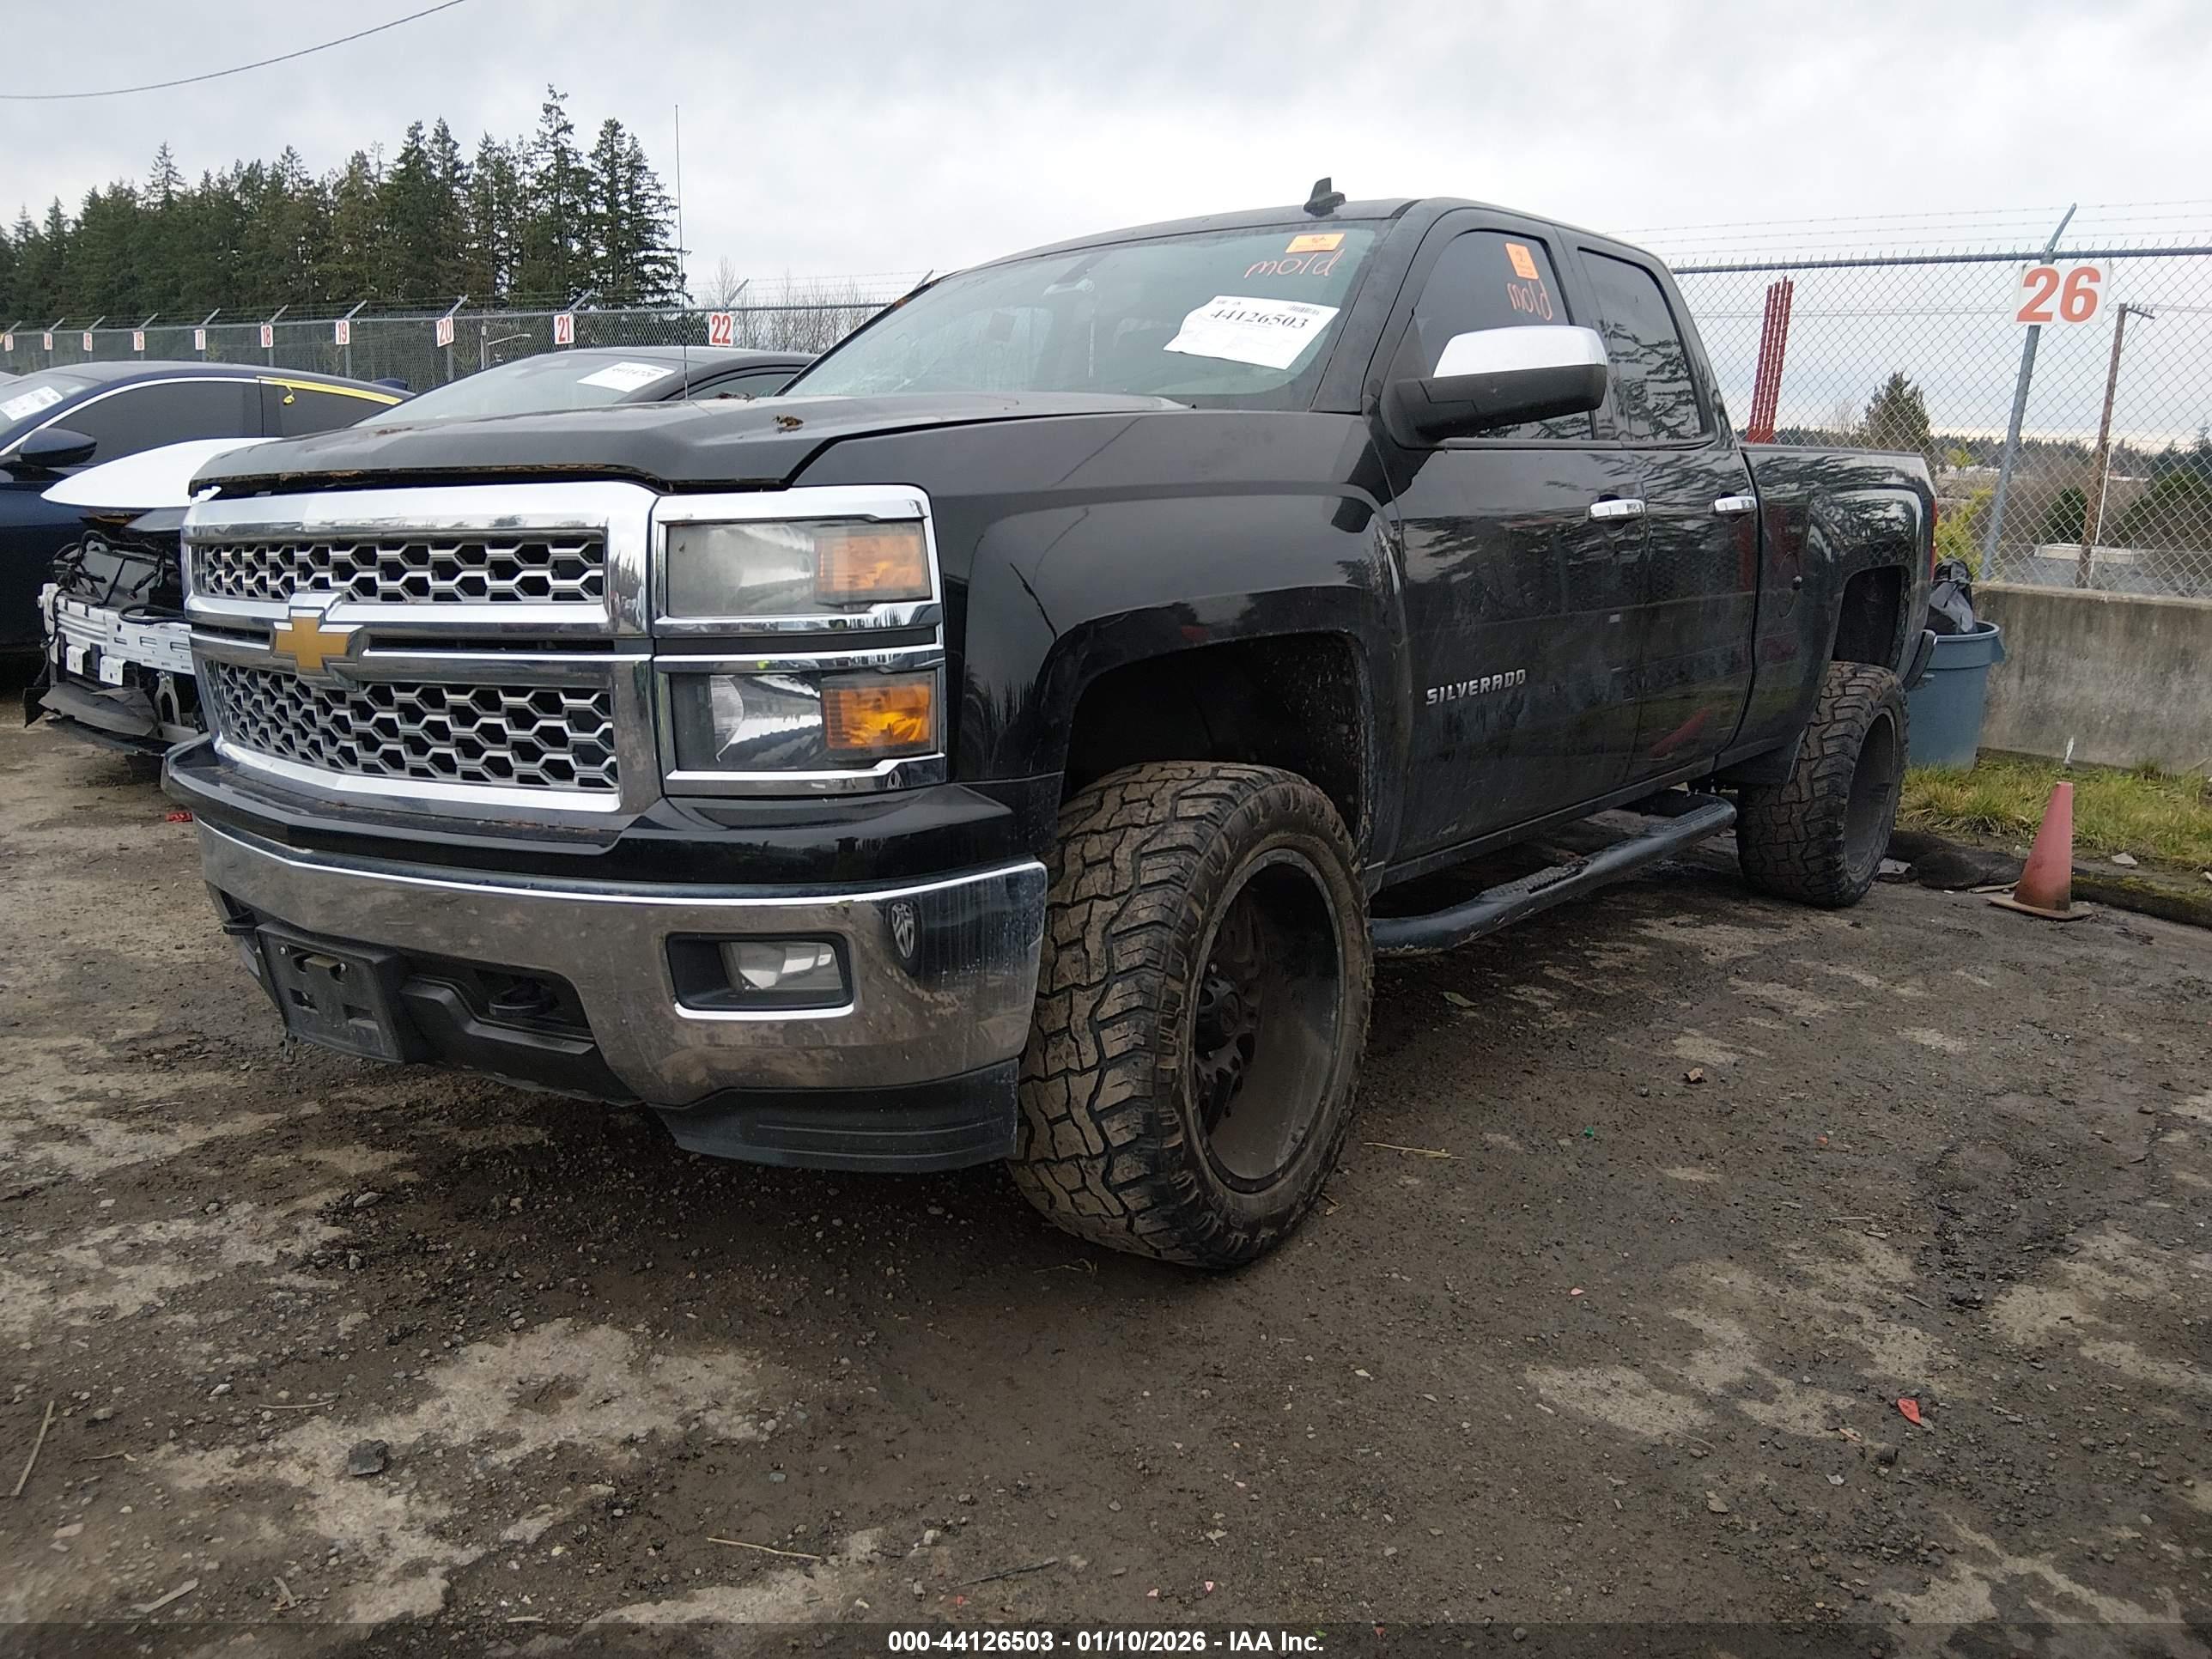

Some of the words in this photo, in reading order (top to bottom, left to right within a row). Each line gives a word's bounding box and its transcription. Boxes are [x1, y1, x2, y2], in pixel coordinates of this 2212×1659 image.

[1244, 247, 1346, 279] mold
[1507, 279, 1553, 321] mold
[2016, 266, 2101, 323] 26
[337, 322, 348, 343] 19
[438, 319, 453, 344] 20
[557, 316, 571, 343] 21
[711, 314, 732, 344] 22
[1210, 308, 1310, 330] 44126503
[263, 326, 271, 346] 18
[1425, 668, 1526, 706] SILVERADO
